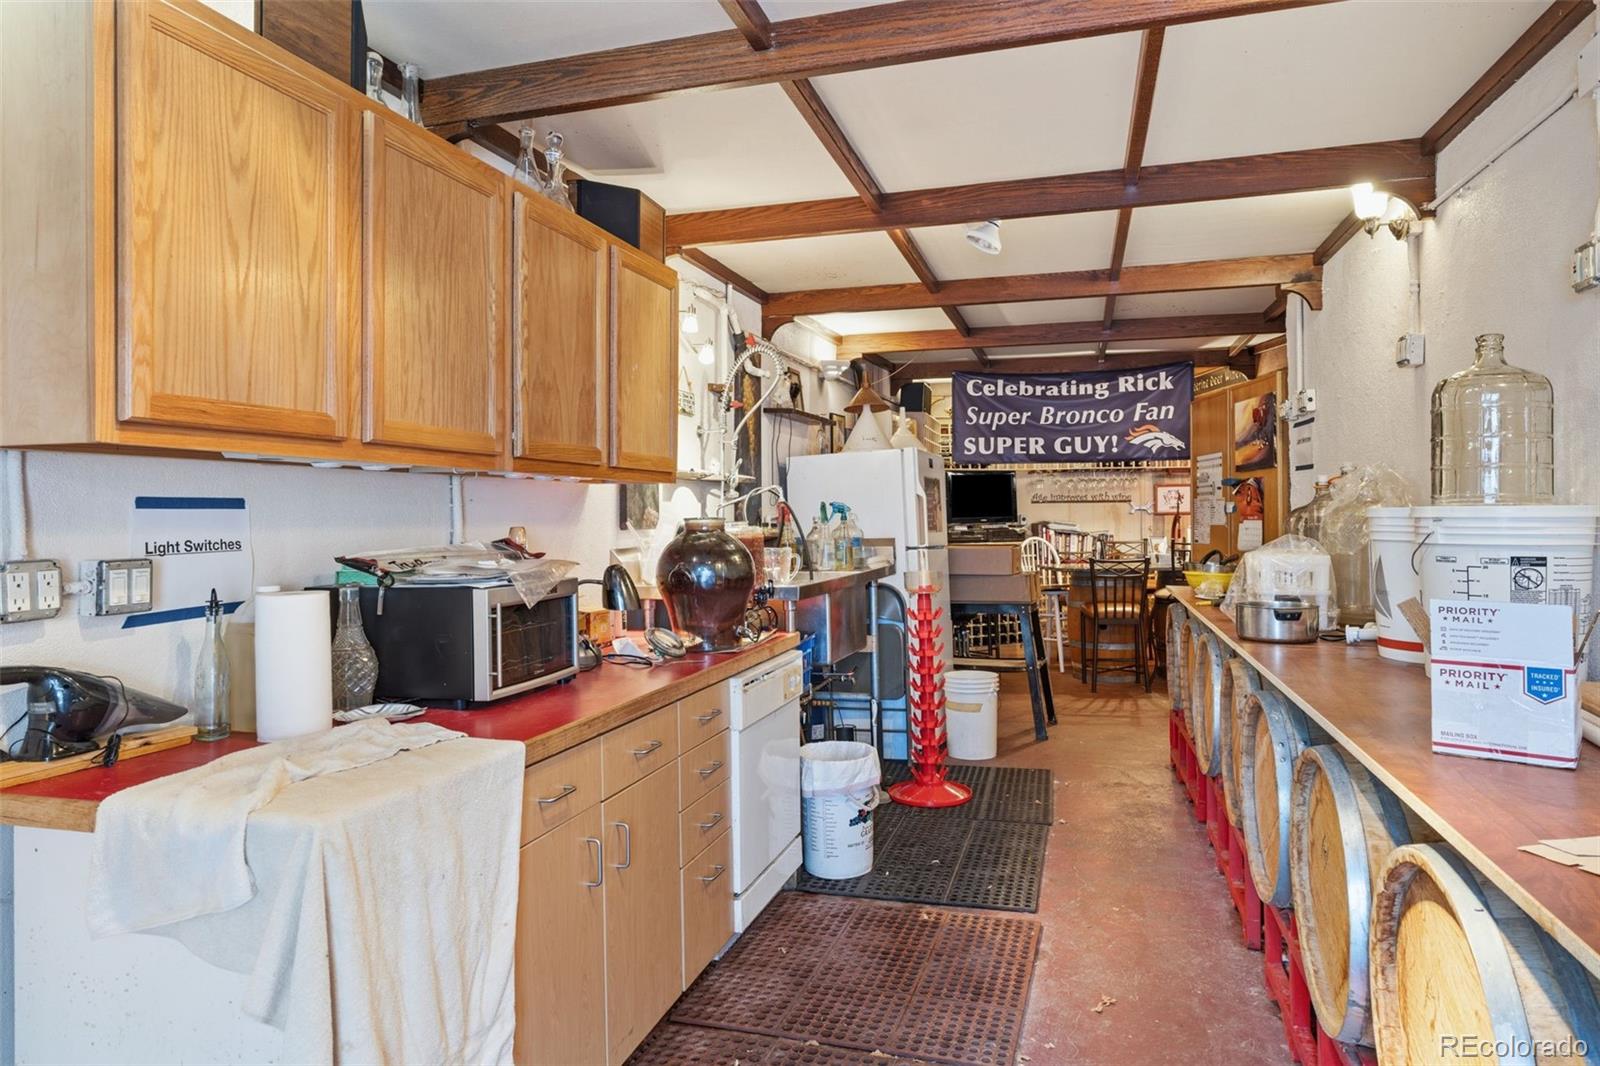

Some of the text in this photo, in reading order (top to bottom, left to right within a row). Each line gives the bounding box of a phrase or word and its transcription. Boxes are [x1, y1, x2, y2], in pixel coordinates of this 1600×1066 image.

[966, 378, 1110, 400] Celebrating
[1118, 371, 1174, 393] Rick
[965, 402, 1175, 430] Super Bronco Fan
[963, 435, 1119, 456] SUPER GUY!
[144, 538, 242, 557] Light Switches
[1438, 606, 1498, 616] PRIORITY
[1452, 616, 1483, 624] MAIL
[1439, 668, 1506, 682] PRIORITY
[1530, 672, 1559, 681] TRACKED
[1454, 679, 1490, 690] MAIL
[1530, 685, 1559, 693] INSURED
